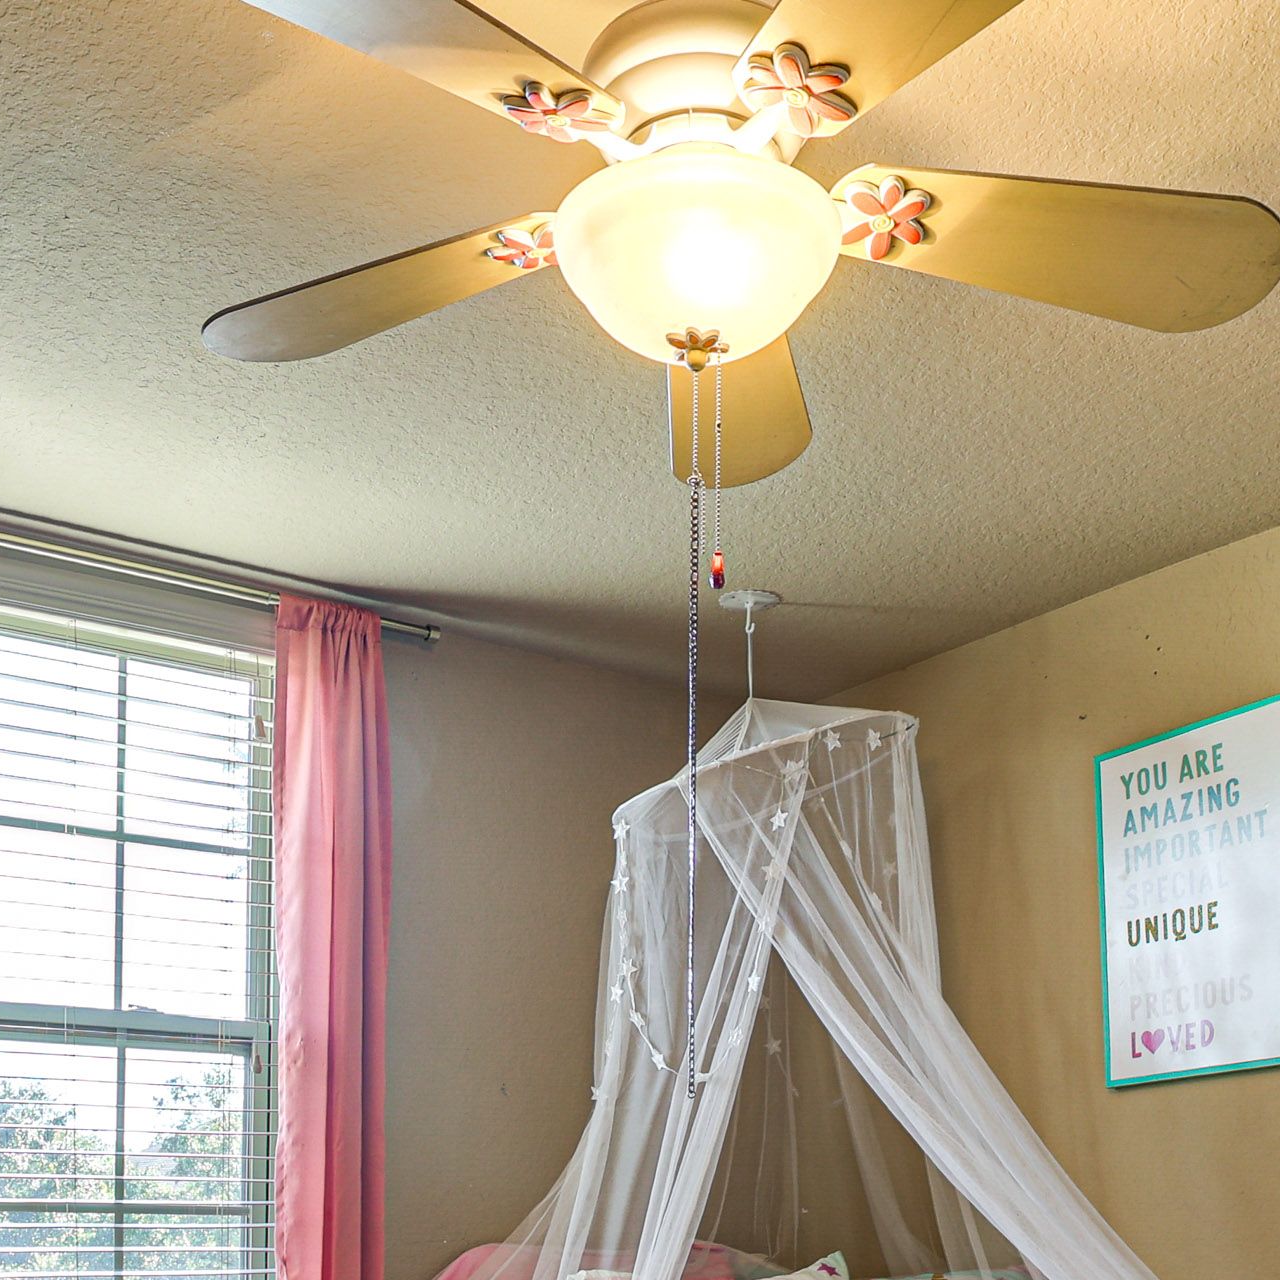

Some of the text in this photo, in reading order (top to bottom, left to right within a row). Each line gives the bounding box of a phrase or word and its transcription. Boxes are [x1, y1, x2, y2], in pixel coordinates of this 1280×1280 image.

[1120, 741, 1226, 800] YOU ARE
[1123, 776, 1241, 838] AMAZING
[1124, 808, 1270, 874] IMPORTANT
[1127, 900, 1220, 948] UNIQUE
[1129, 972, 1254, 1022] PRECIOUS
